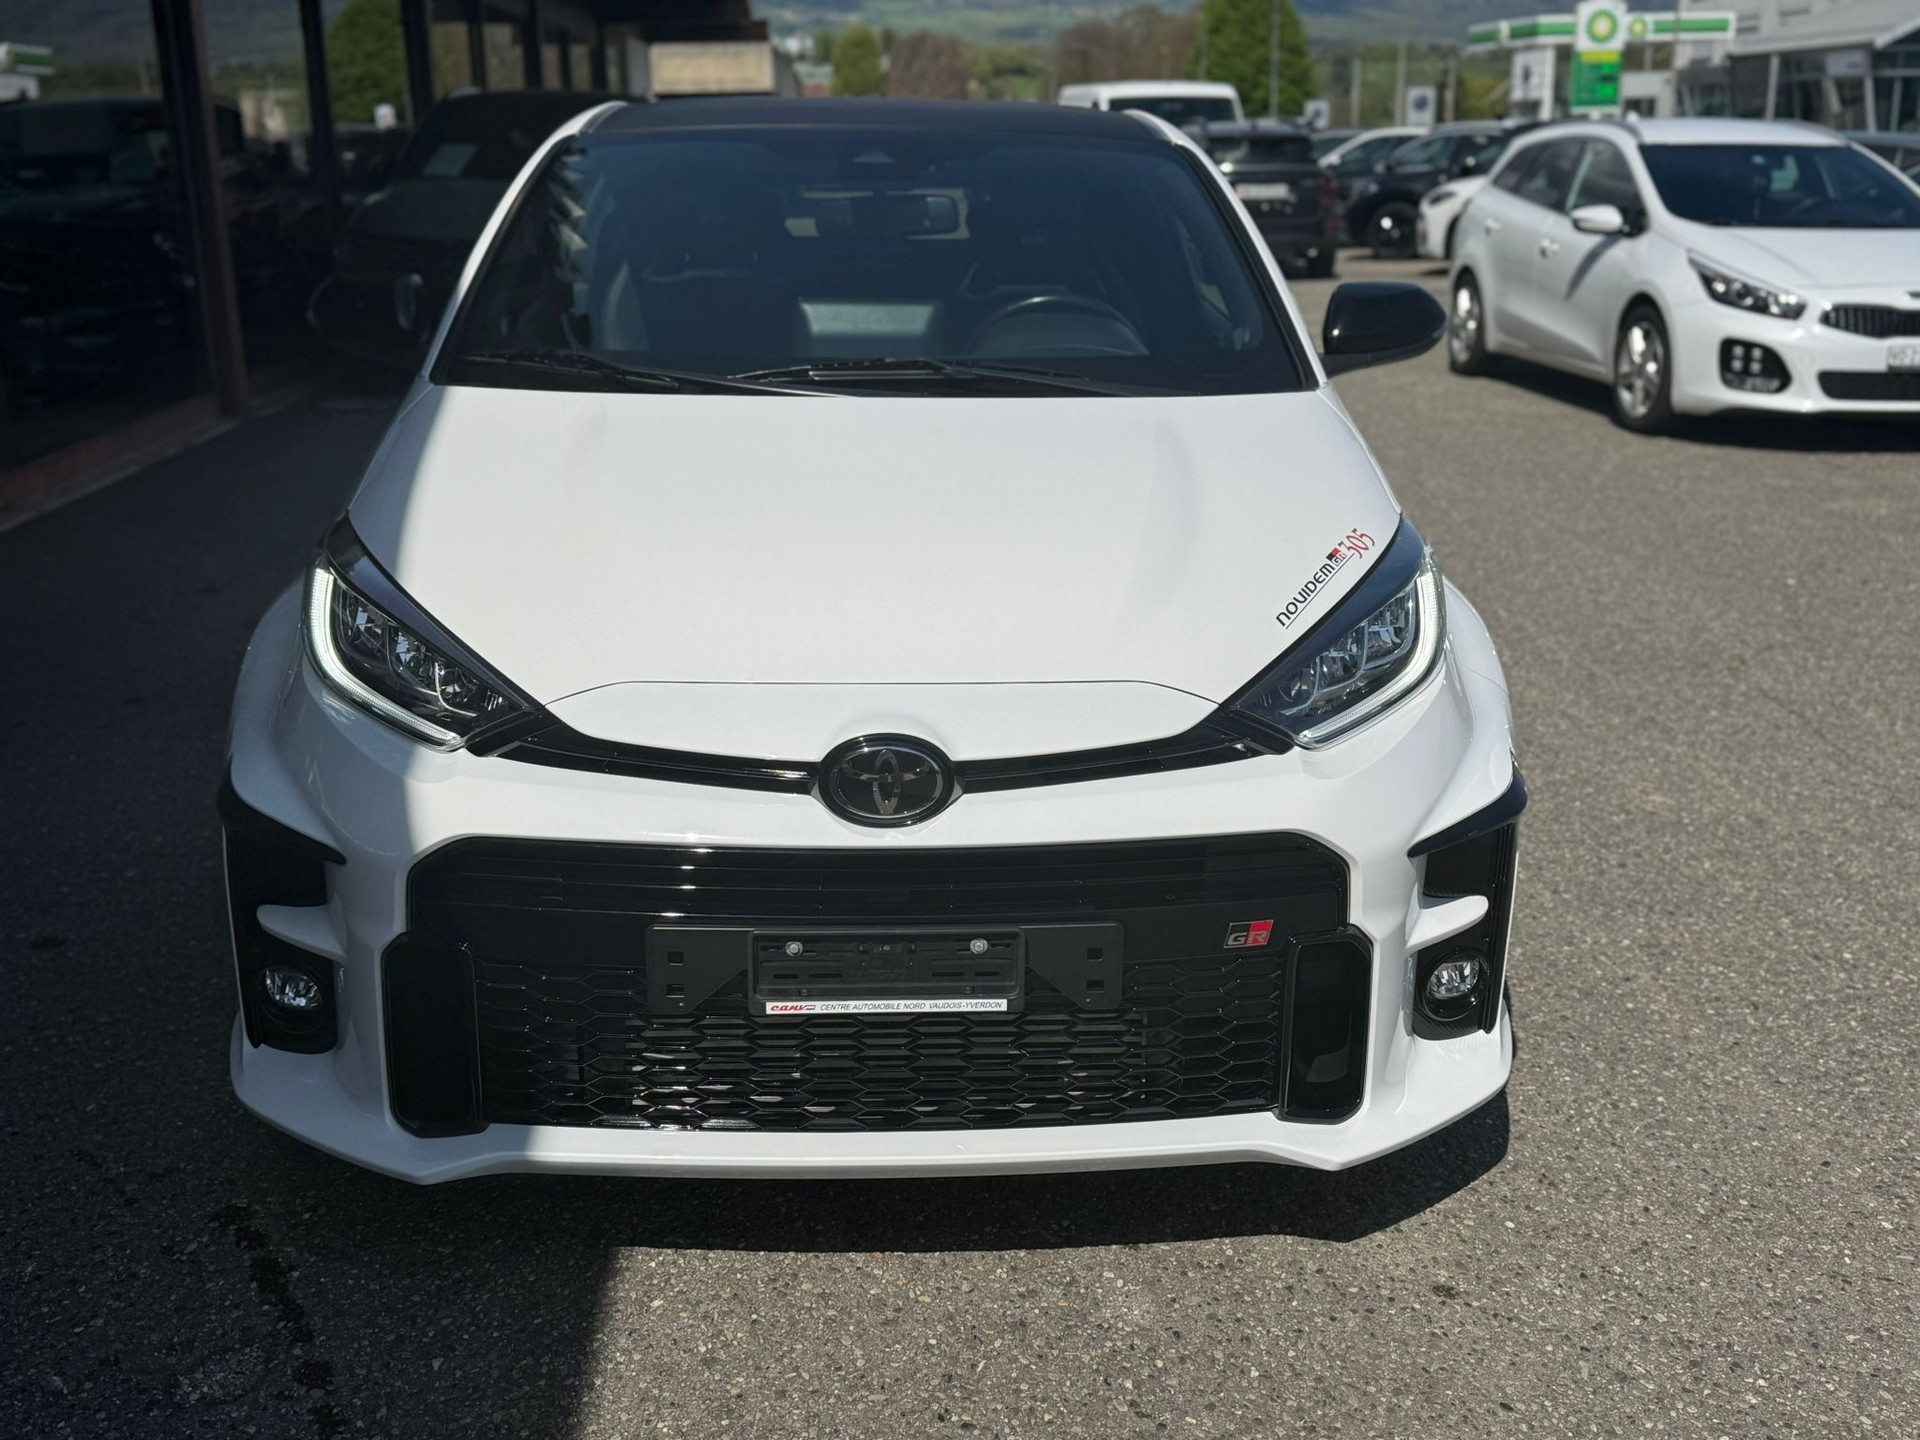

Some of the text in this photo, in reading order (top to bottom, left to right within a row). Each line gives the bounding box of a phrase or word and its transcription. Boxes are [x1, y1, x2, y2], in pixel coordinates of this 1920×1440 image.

[1337, 527, 1375, 559] 305
[1227, 930, 1269, 946] GR
[820, 1003, 851, 1011] CENTRE
[852, 1002, 901, 1010] AUTOMOBILE
[903, 1002, 926, 1010] NORD
